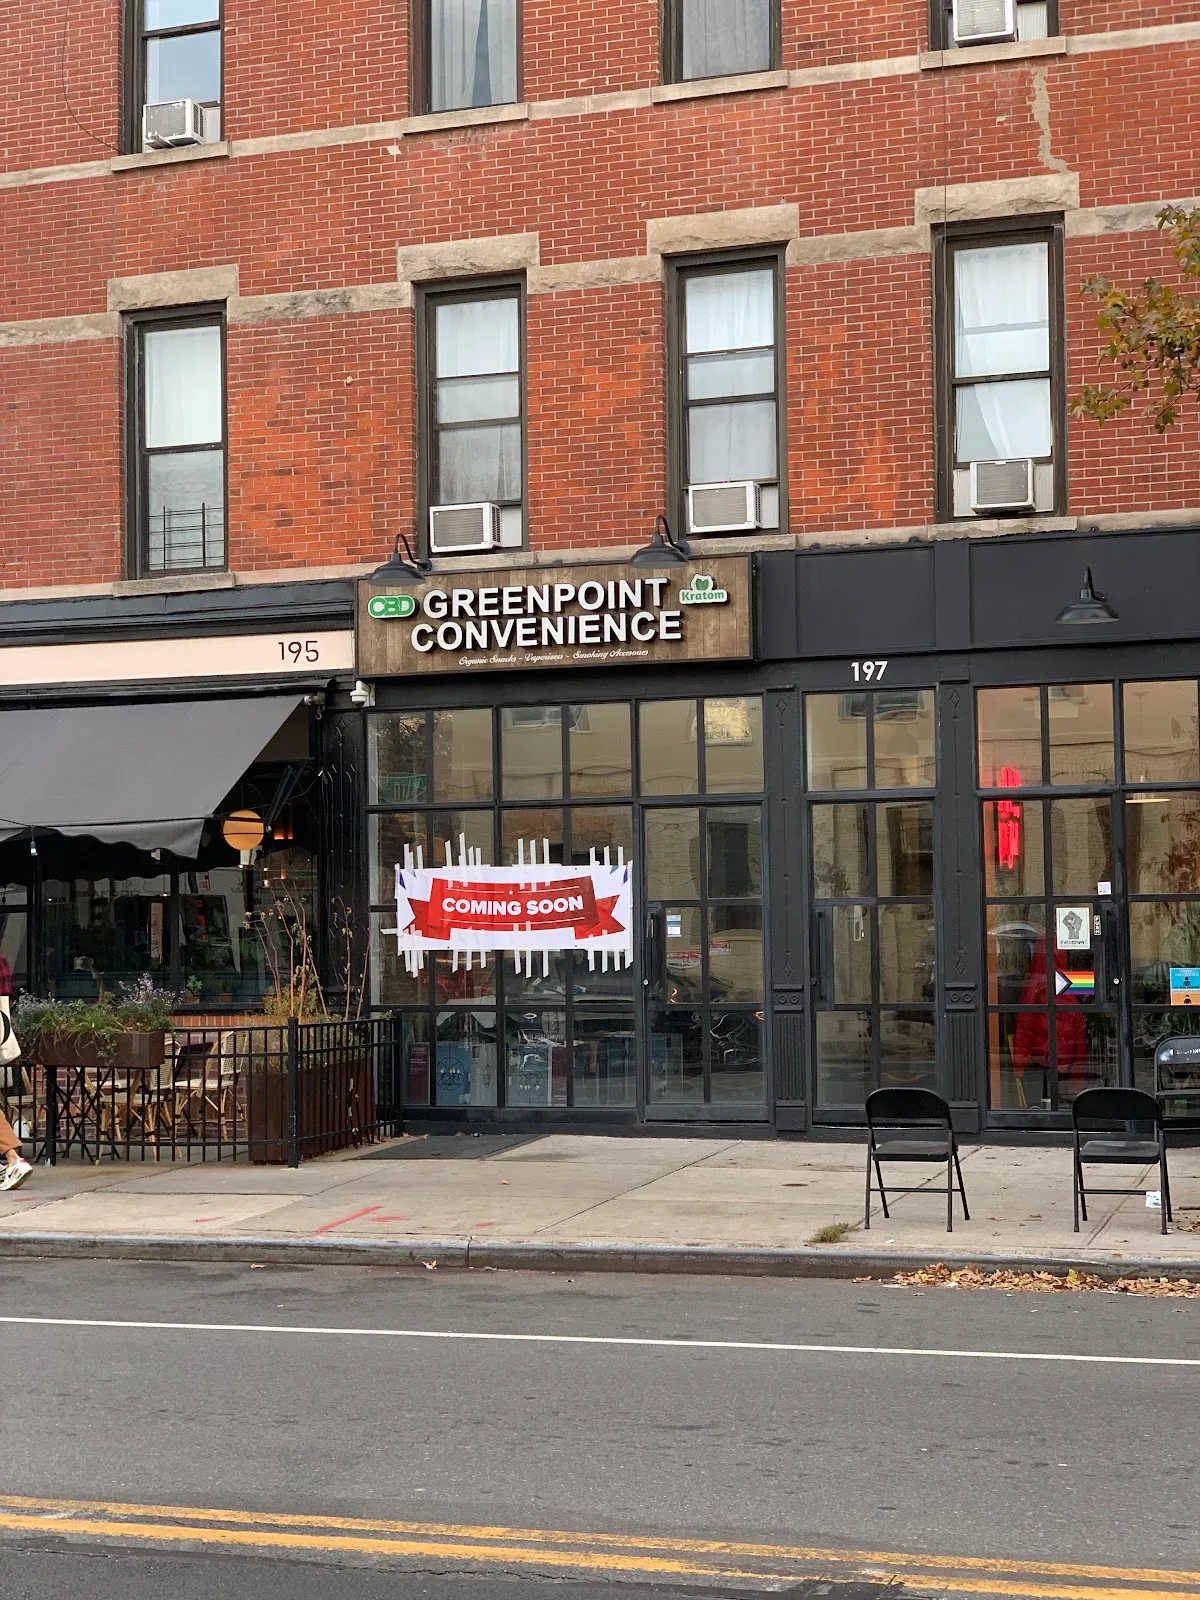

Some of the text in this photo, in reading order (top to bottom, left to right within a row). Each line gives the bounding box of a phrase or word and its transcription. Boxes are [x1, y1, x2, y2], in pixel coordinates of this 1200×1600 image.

[368, 595, 415, 618] CBD
[423, 577, 669, 619] GREENPOINT
[682, 591, 724, 601] Kratom
[411, 610, 682, 652] CONVENIENCE
[278, 640, 319, 663] 195
[458, 656, 488, 667] Organic
[489, 654, 517, 664] Snacks
[572, 649, 608, 660] Smoking
[850, 661, 888, 682] 197
[442, 895, 584, 916] COMING SOON
